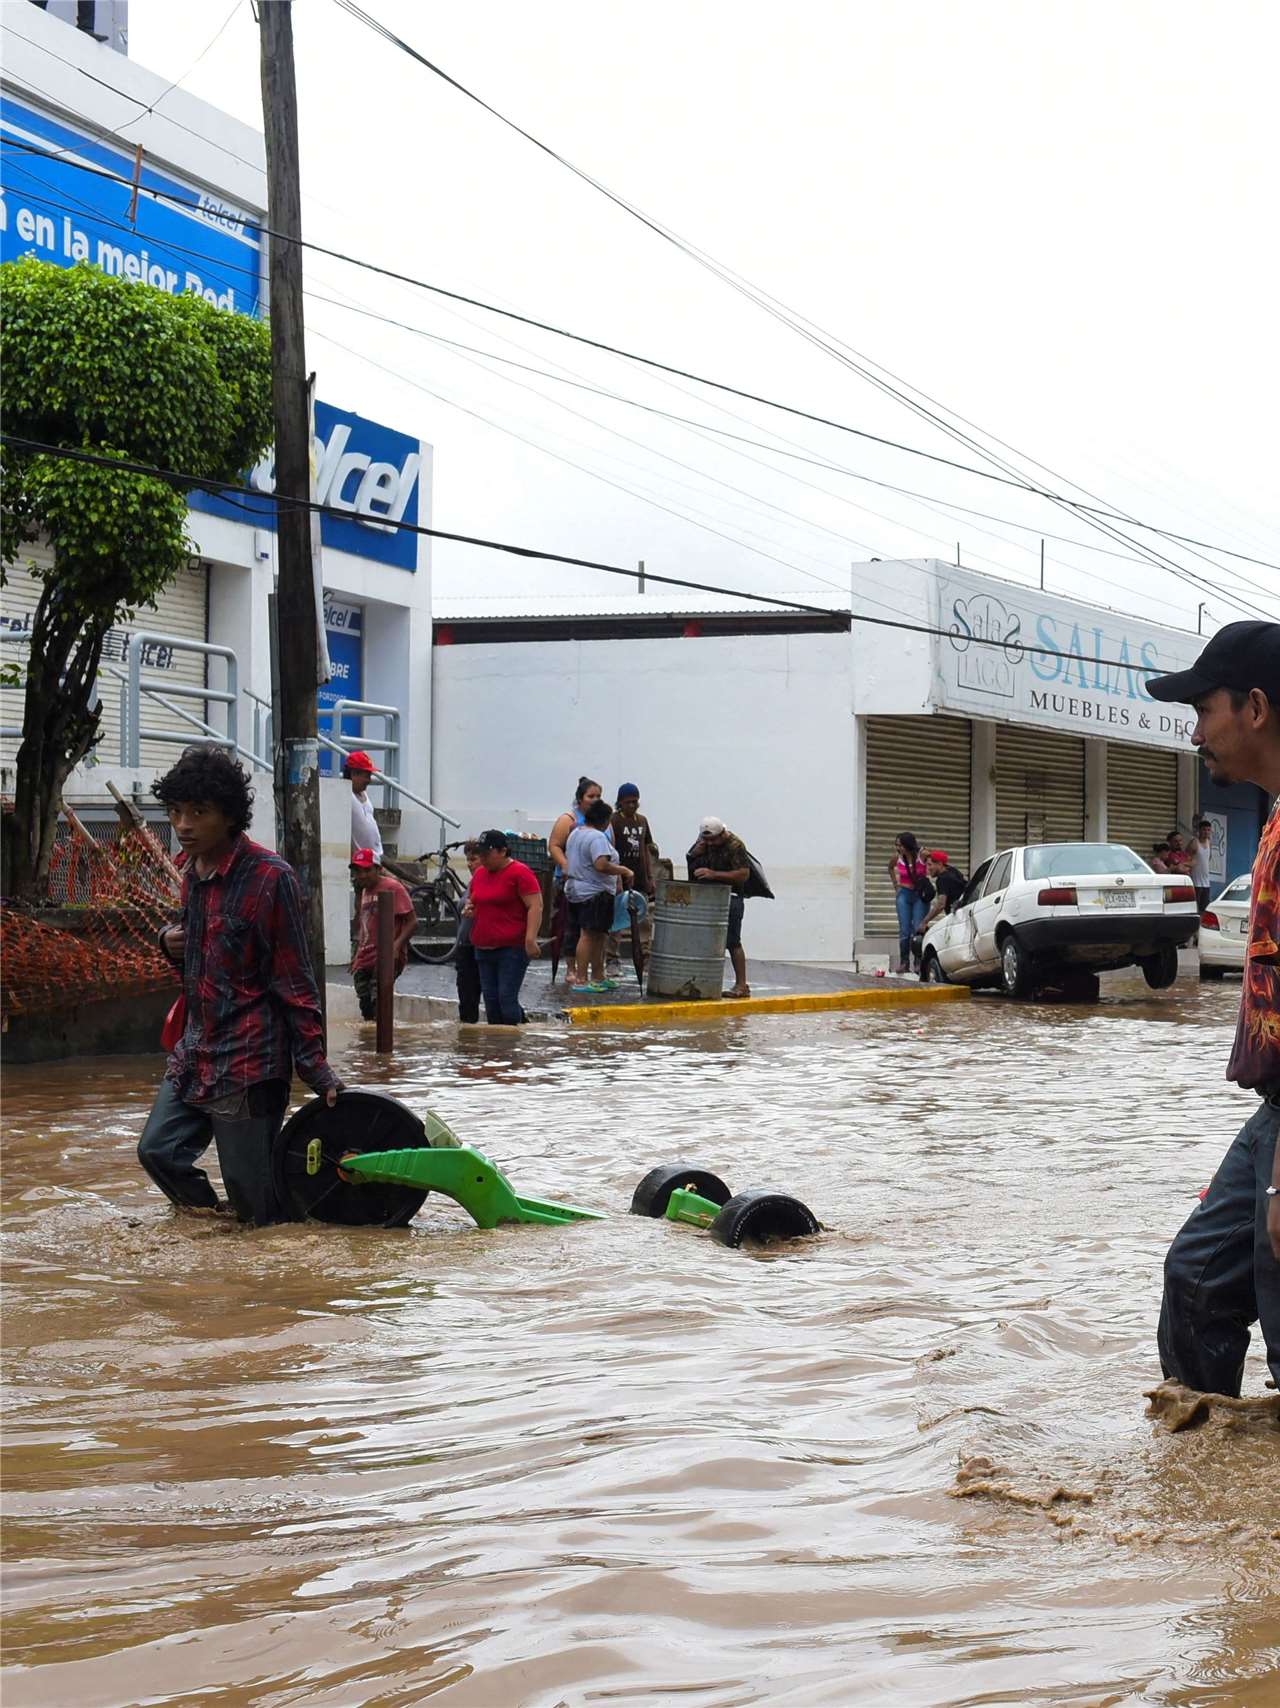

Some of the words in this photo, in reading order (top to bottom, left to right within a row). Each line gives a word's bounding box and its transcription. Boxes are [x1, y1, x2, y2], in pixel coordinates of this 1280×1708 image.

[16, 208, 55, 251] en
[63, 216, 89, 261] la
[97, 240, 178, 296] mejor
[1030, 613, 1161, 703] SALAS
[1029, 689, 1130, 725] MUEBLES
[1138, 712, 1151, 729] &
